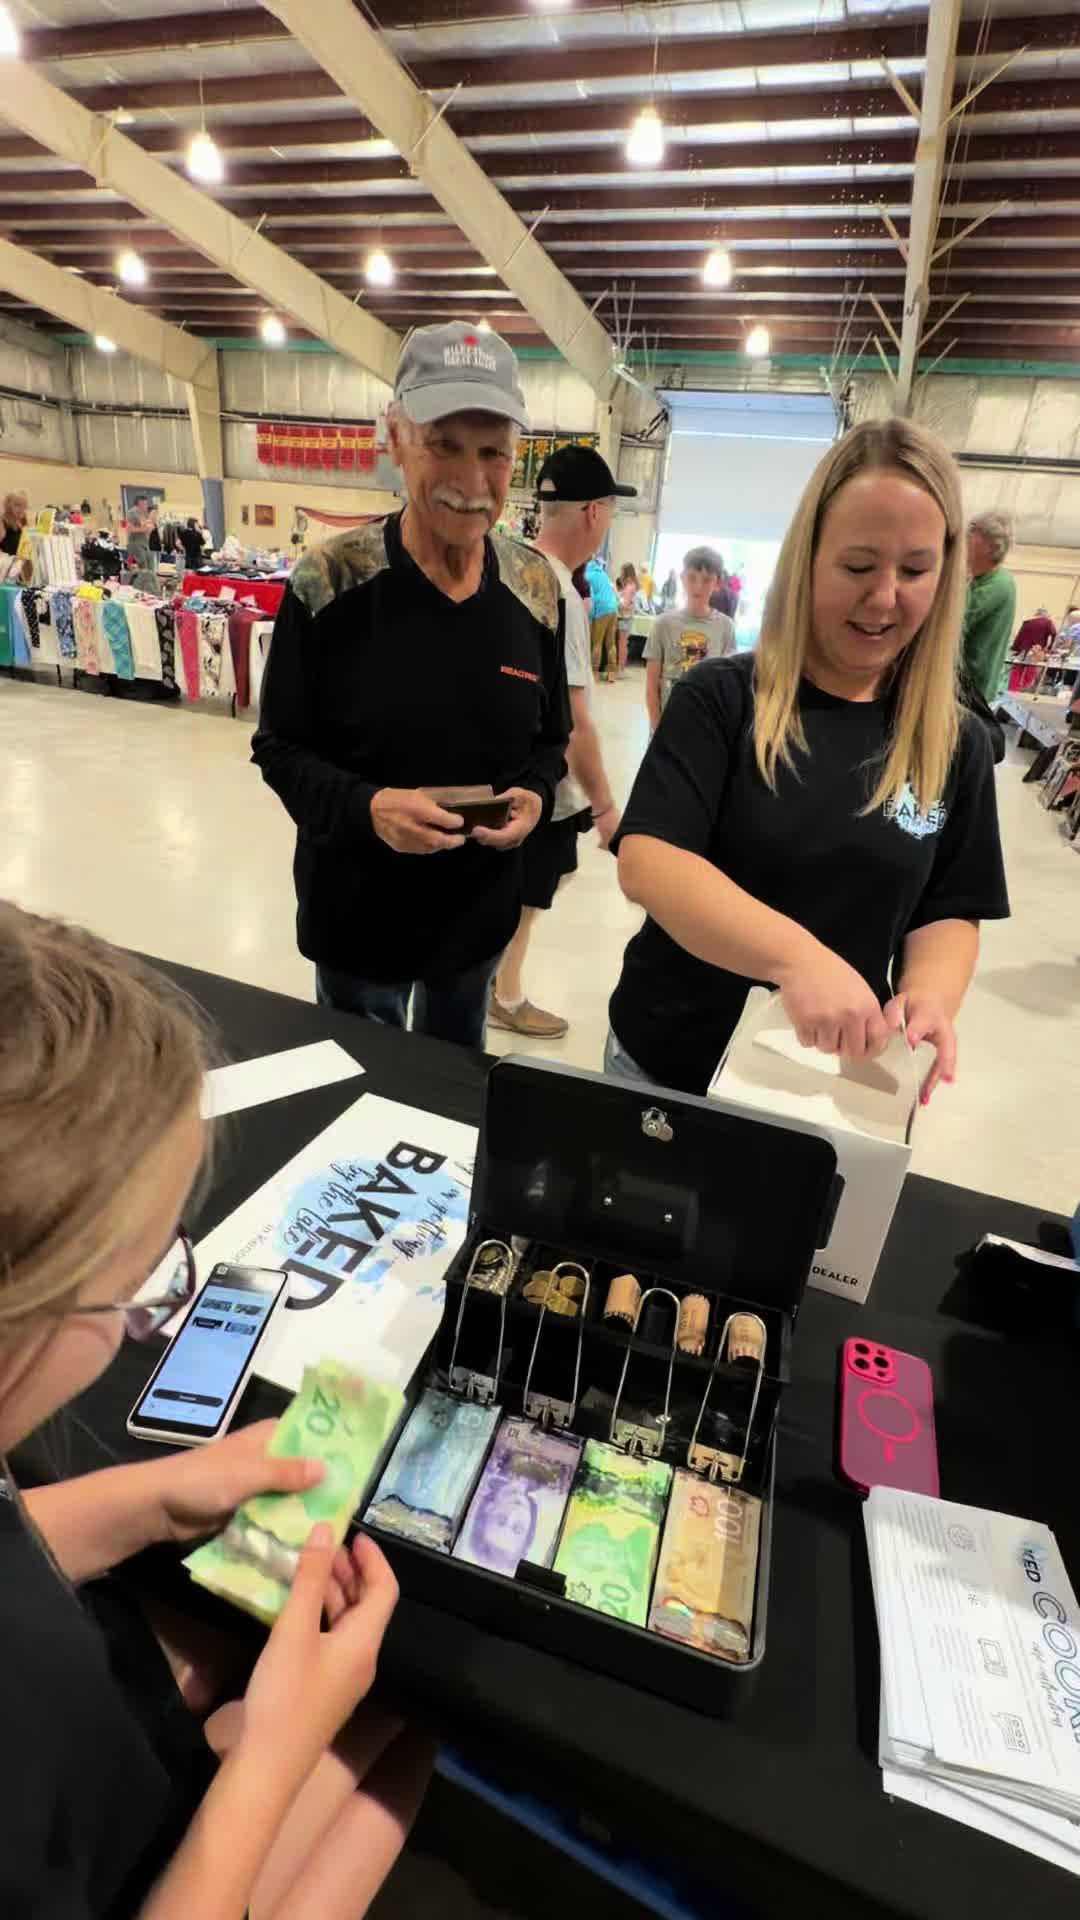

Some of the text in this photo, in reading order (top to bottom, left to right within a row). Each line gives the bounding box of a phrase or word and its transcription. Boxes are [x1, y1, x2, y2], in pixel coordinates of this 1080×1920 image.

[329, 1163, 374, 1183] by
[318, 1181, 357, 1207] the
[280, 1140, 447, 1310] BAKED
[812, 1266, 858, 1286] DEALER
[306, 1384, 341, 1437] 20
[713, 1500, 743, 1544] 100
